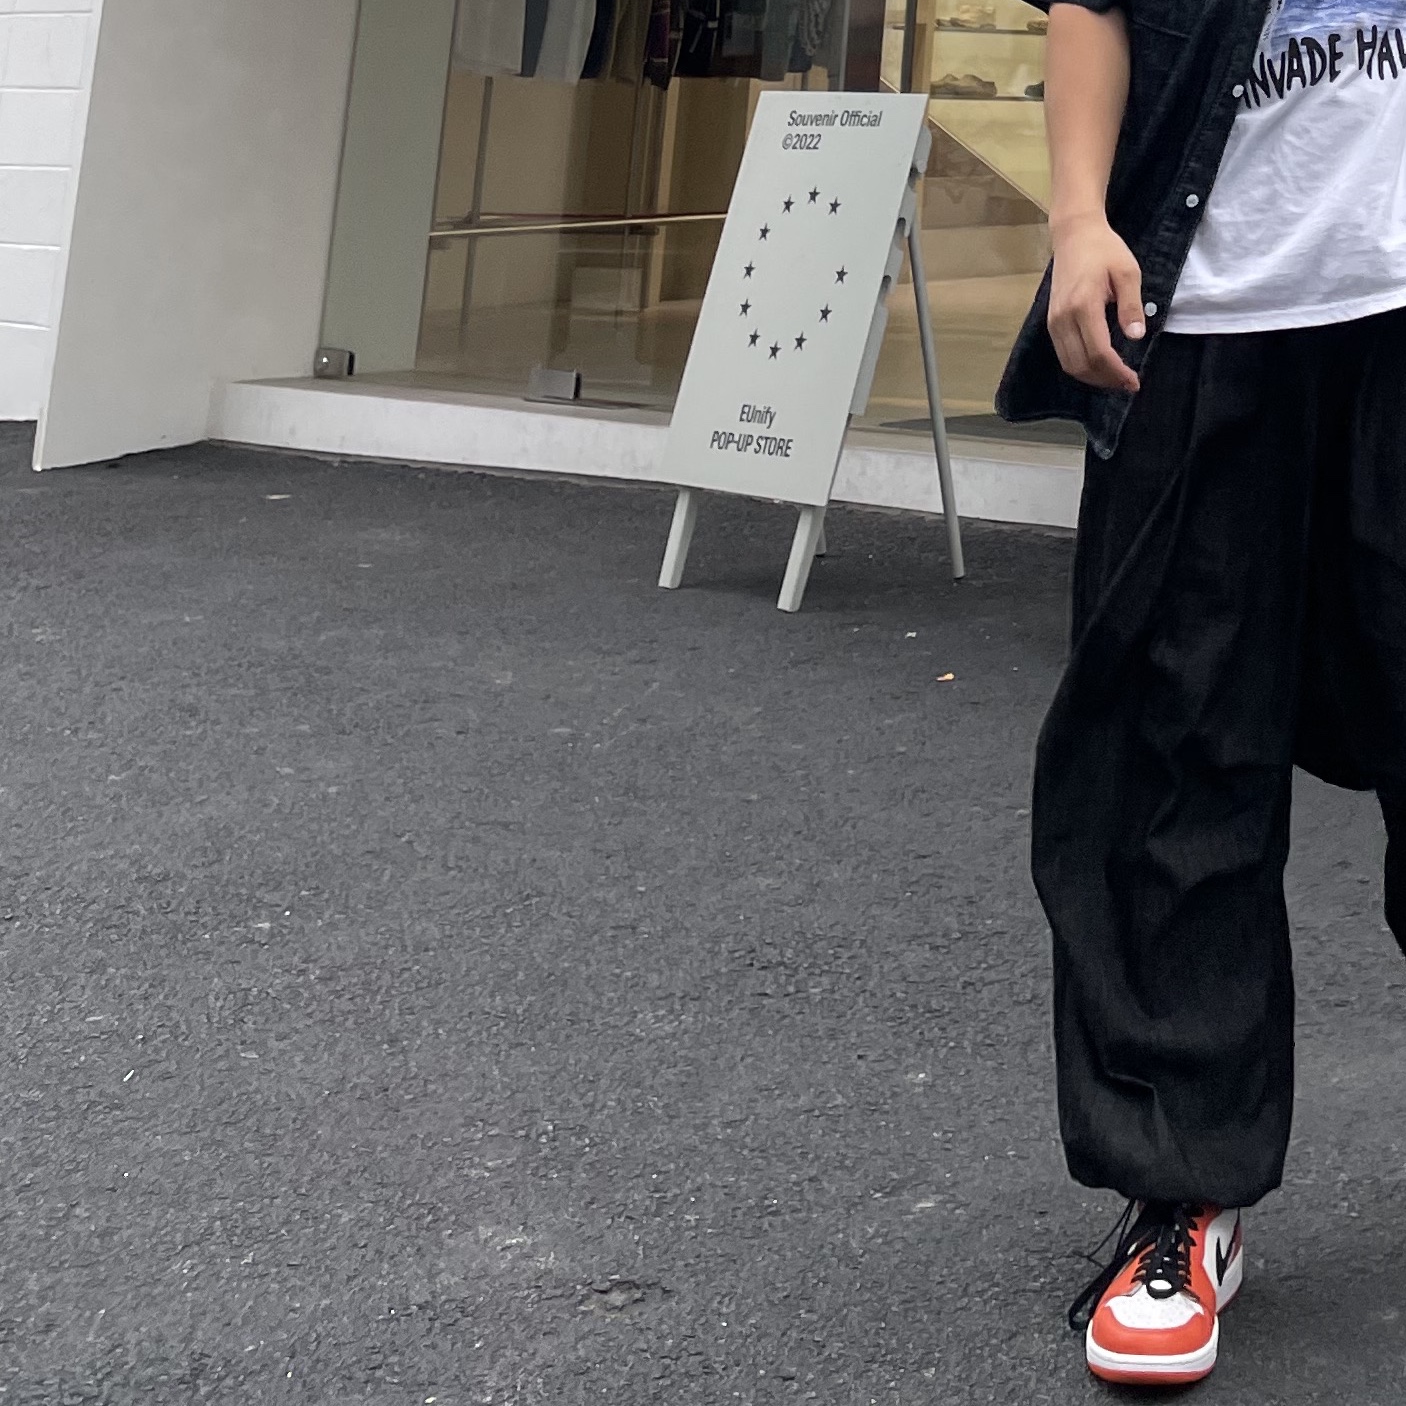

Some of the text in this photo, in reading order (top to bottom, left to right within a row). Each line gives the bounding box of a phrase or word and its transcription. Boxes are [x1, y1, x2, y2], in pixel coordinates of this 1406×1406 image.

[788, 109, 883, 127] Souvenir Official
[739, 403, 777, 429] EUnify
[709, 430, 794, 457] POP-UP STORE
